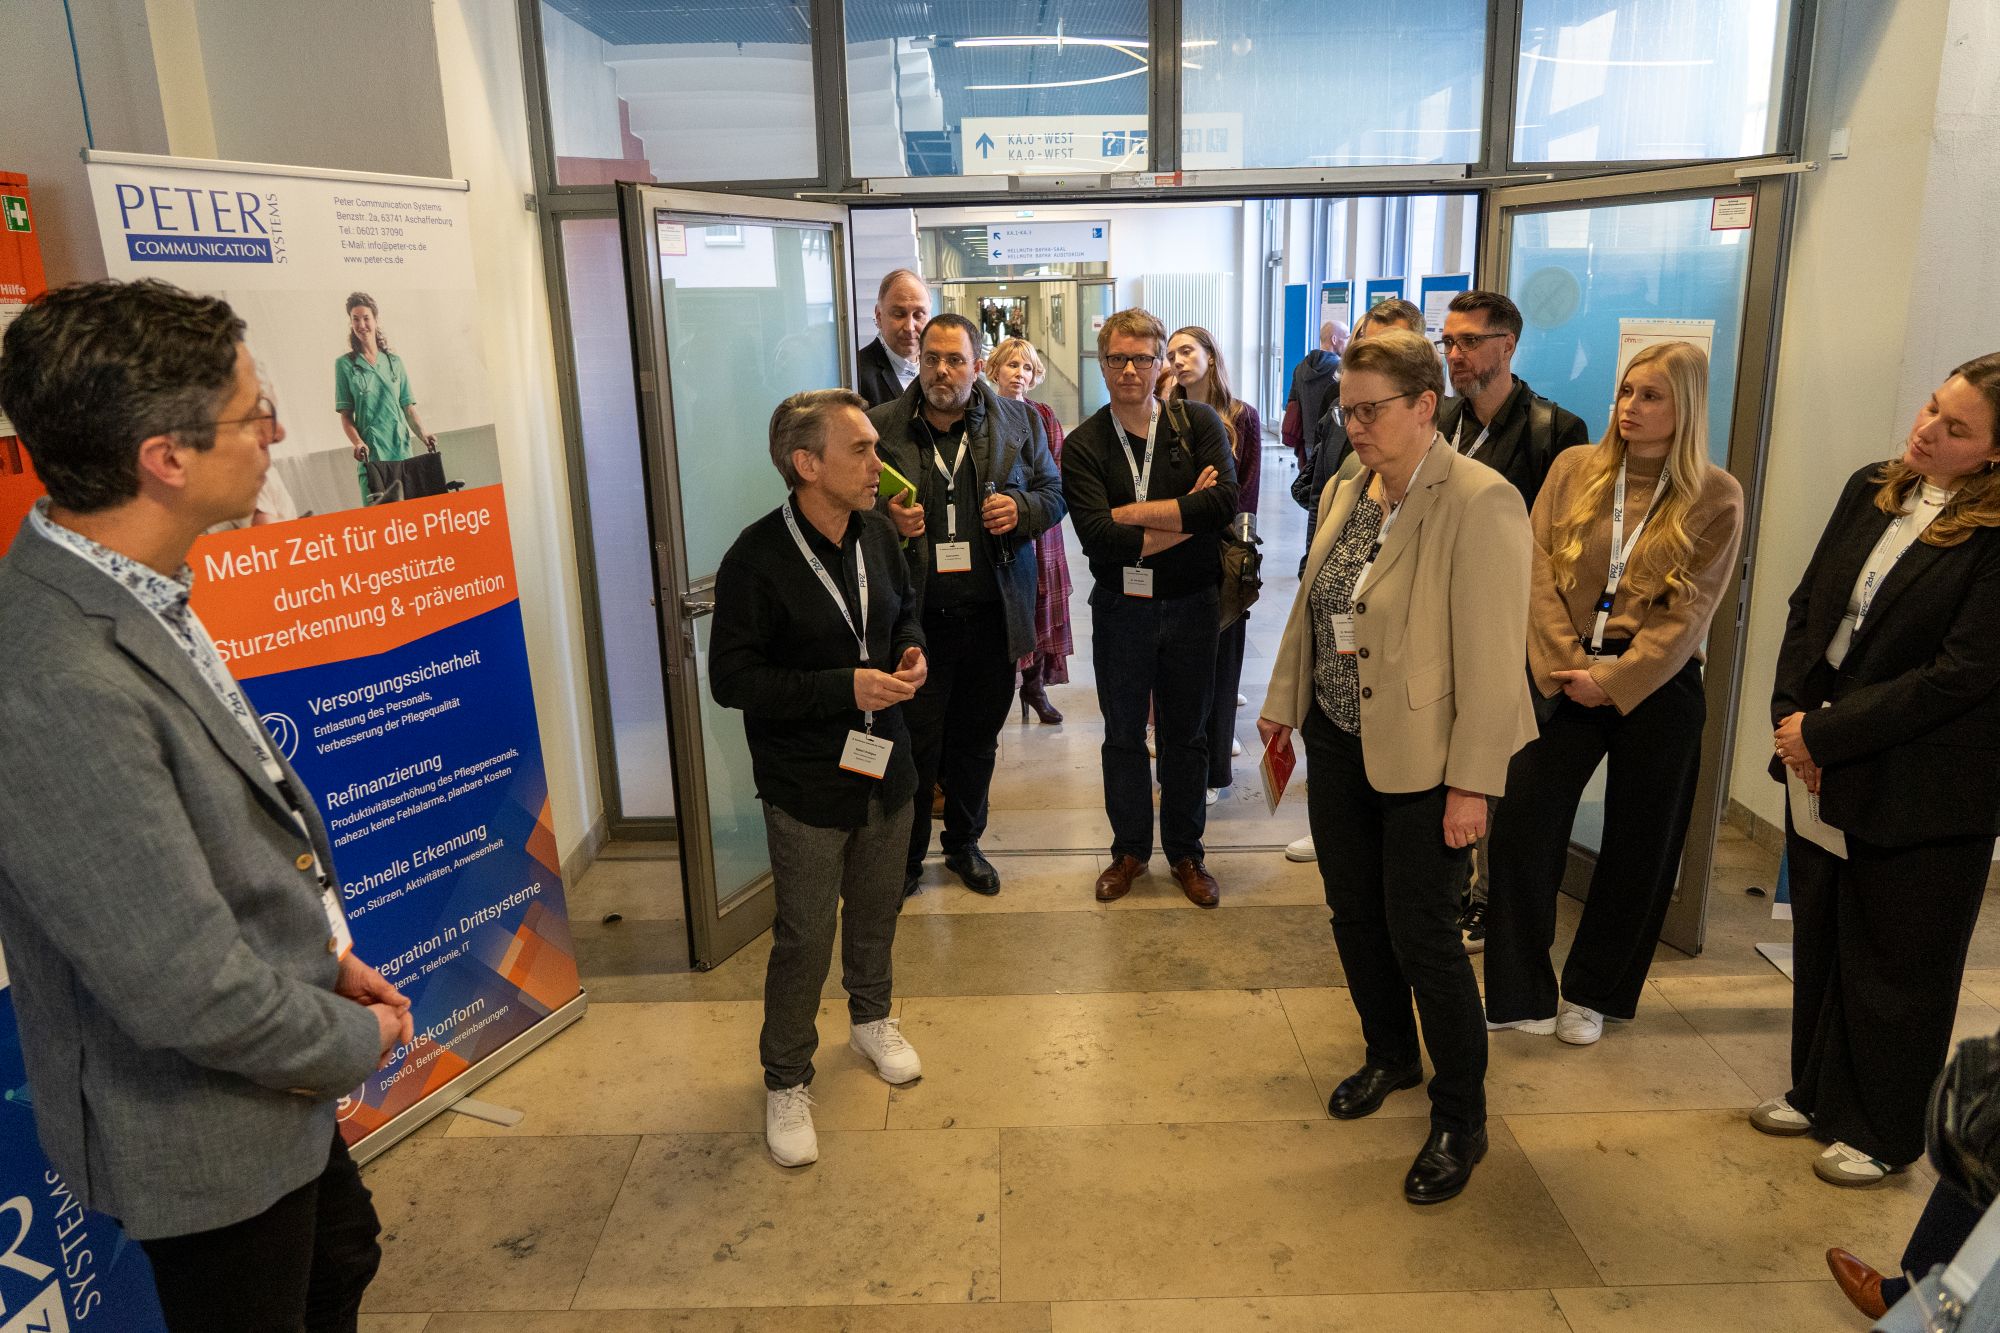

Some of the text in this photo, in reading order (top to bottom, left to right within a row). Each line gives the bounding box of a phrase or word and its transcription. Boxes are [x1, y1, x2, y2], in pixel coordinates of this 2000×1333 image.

[115, 184, 268, 234] PETER
[266, 193, 287, 264] SYSTEMS
[333, 197, 442, 212] Peter Communication Systems
[336, 212, 453, 227] Benzstr. 2a, 63741 Aschaffenburg
[356, 226, 379, 236] 06021
[381, 227, 404, 237] 37090
[135, 241, 267, 257] COMMUNICATION
[341, 240, 427, 252] E-Mail: info@peter-cs.de
[343, 255, 404, 265] www.peter-cs.de
[204, 507, 490, 583] Mehr Zeit für die Pflege
[274, 555, 456, 612] durch KI-gestützte
[212, 574, 505, 663] Sturzerkennung & -prävention
[307, 649, 481, 716] Versorgungssicherheit
[313, 690, 433, 738] Entlastung des Personals,
[316, 697, 461, 755] Verbesserung der Pflegequalität
[326, 754, 443, 810] Refinanzierung
[331, 747, 519, 831] Produktivitätserhöhung des Pflegepersonals,
[334, 766, 512, 848] nahezu keine Fehlalarme, planbare Kosten
[343, 824, 488, 900] Schnelle Erkennung
[348, 838, 504, 920] von Stürzen, Aktivitäten, Anwesenheit
[376, 882, 541, 977] tegration in Drittsysteme
[420, 950, 462, 975] Telefonie,
[462, 941, 470, 953] IT
[378, 997, 486, 1072] echtskonform
[380, 1005, 509, 1091] DSGVO, Betriebsvereinbarungen
